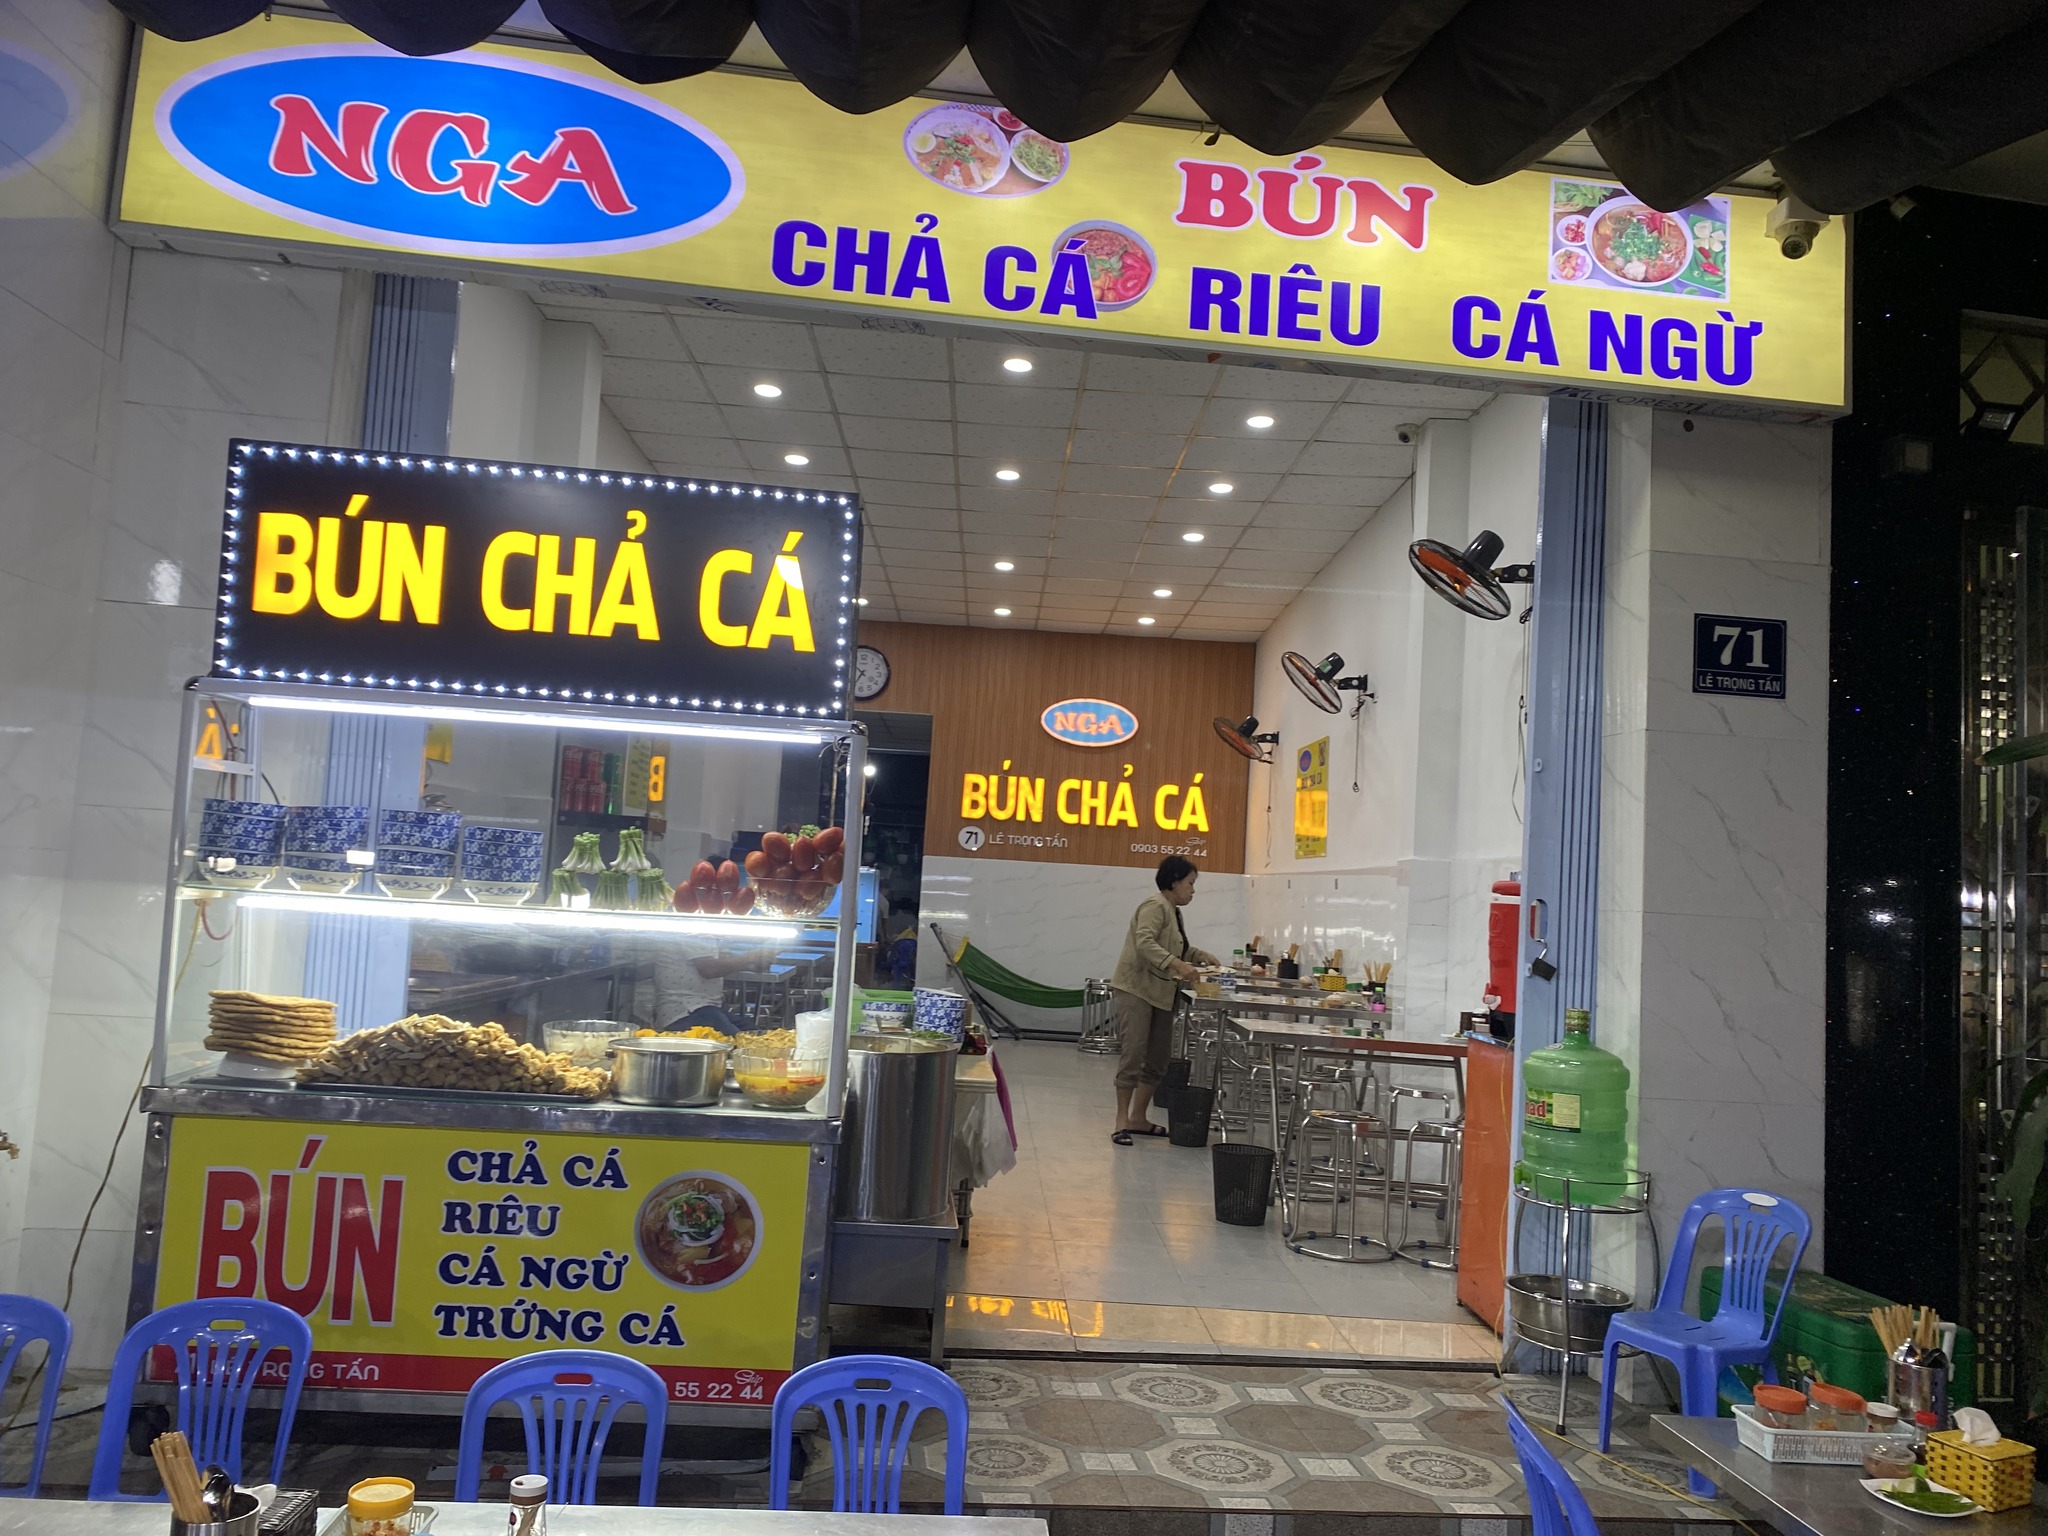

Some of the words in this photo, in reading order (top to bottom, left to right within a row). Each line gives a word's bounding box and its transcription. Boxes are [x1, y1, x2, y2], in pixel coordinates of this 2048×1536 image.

[268, 94, 638, 215] NGA
[1177, 152, 1434, 250] BÚN
[773, 213, 950, 303] CHẢ
[985, 239, 1098, 319] CÁ
[1190, 260, 1380, 346] RIÊU
[1453, 289, 1559, 367] CÁ
[1589, 309, 1763, 387] NGỪ
[252, 494, 447, 625] BÚN
[481, 509, 661, 641] CHẢ
[699, 530, 816, 653] CÁ
[1713, 625, 1769, 668] 71
[1699, 673, 1714, 687] LÊ
[1716, 676, 1755, 691] TRỌNG
[1758, 675, 1780, 692] TẤN
[1053, 711, 1125, 737] NGA
[961, 759, 1046, 823] BÚN
[1056, 763, 1139, 828] CHẢ
[1154, 772, 1210, 833] CÁ
[965, 831, 978, 845] 71
[989, 832, 1004, 845] LÊ
[1130, 843, 1158, 853] 0903
[1160, 845, 1174, 854] 55
[1176, 846, 1190, 855] 22
[1193, 848, 1207, 857] 44
[447, 1140, 549, 1186] CHẢ
[563, 1148, 629, 1189] CÁ
[197, 1138, 404, 1323] BÚN
[442, 1195, 560, 1238] RIÊU
[438, 1245, 506, 1288] CÁ
[520, 1251, 629, 1292] NGỪ
[434, 1298, 605, 1343] TRỨNG
[619, 1304, 685, 1346] CÁ
[674, 1382, 699, 1398] 55
[707, 1383, 733, 1399] 22
[740, 1385, 763, 1400] 44
